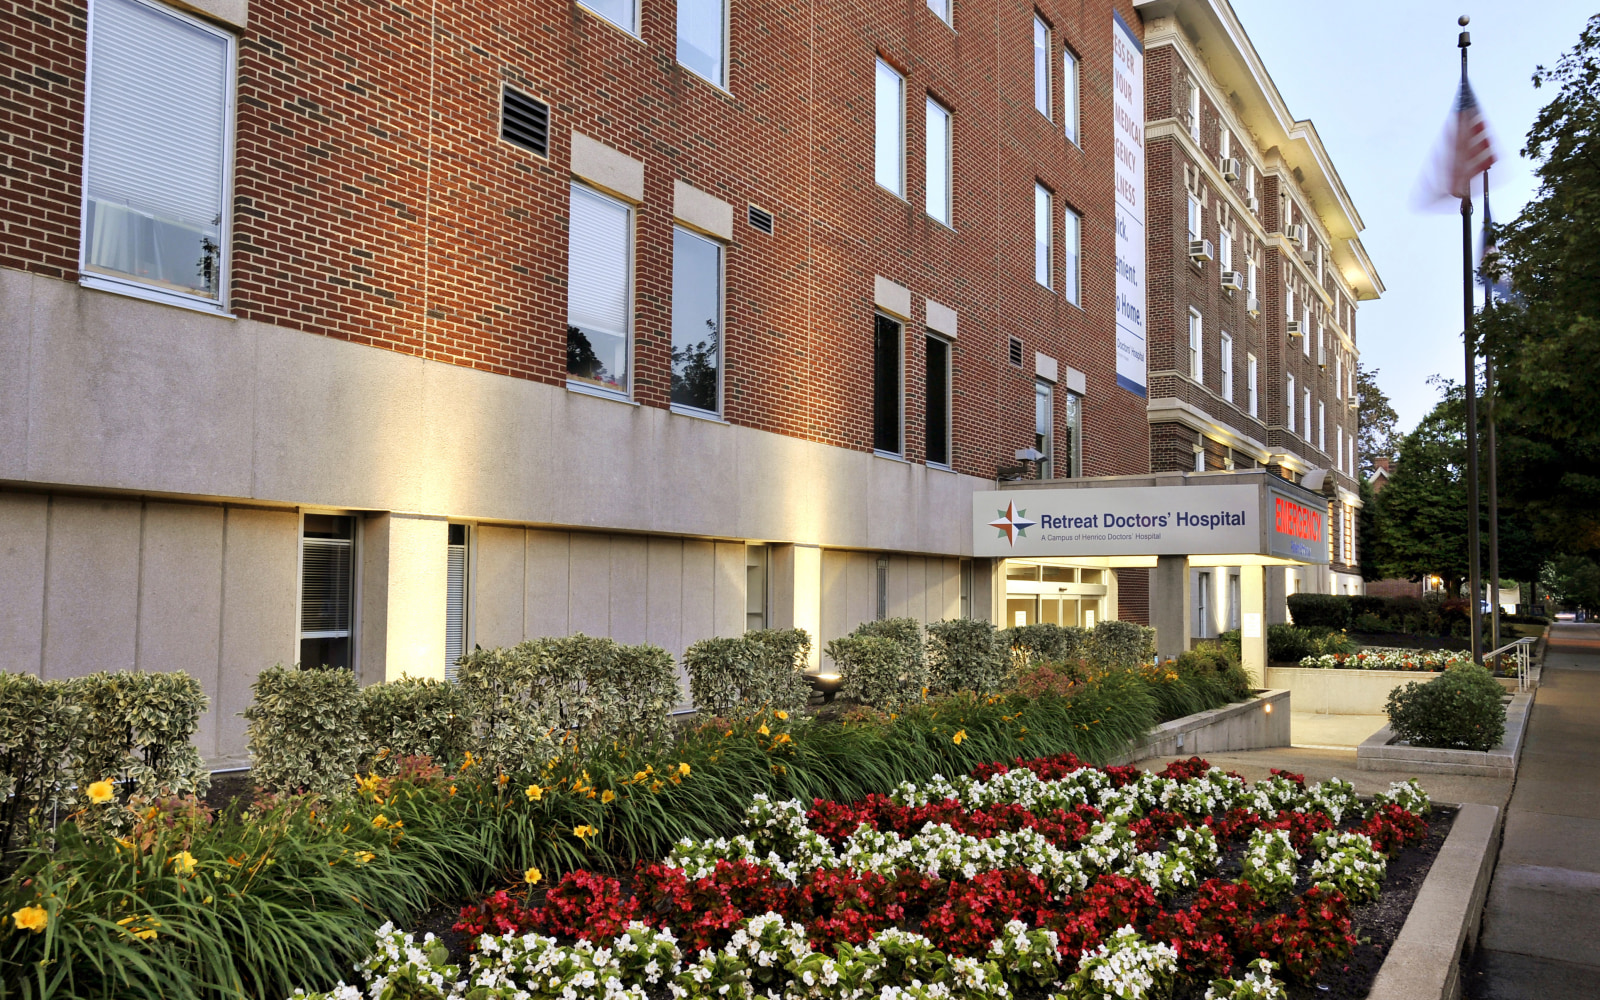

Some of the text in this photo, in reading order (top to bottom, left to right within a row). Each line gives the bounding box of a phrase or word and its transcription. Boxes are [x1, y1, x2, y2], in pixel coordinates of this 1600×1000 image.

[1114, 67, 1133, 106] YOUR
[1115, 101, 1142, 149] MEDICAL
[1121, 292, 1142, 327] Home.
[1041, 510, 1246, 531] Retreat Doctors' Hospital
[1047, 534, 1073, 542] Campus
[1082, 533, 1106, 541] Henrico
[1107, 532, 1134, 541] Doctors'
[1135, 532, 1162, 541] Hospital
[1275, 497, 1322, 543] EMERGENCY
